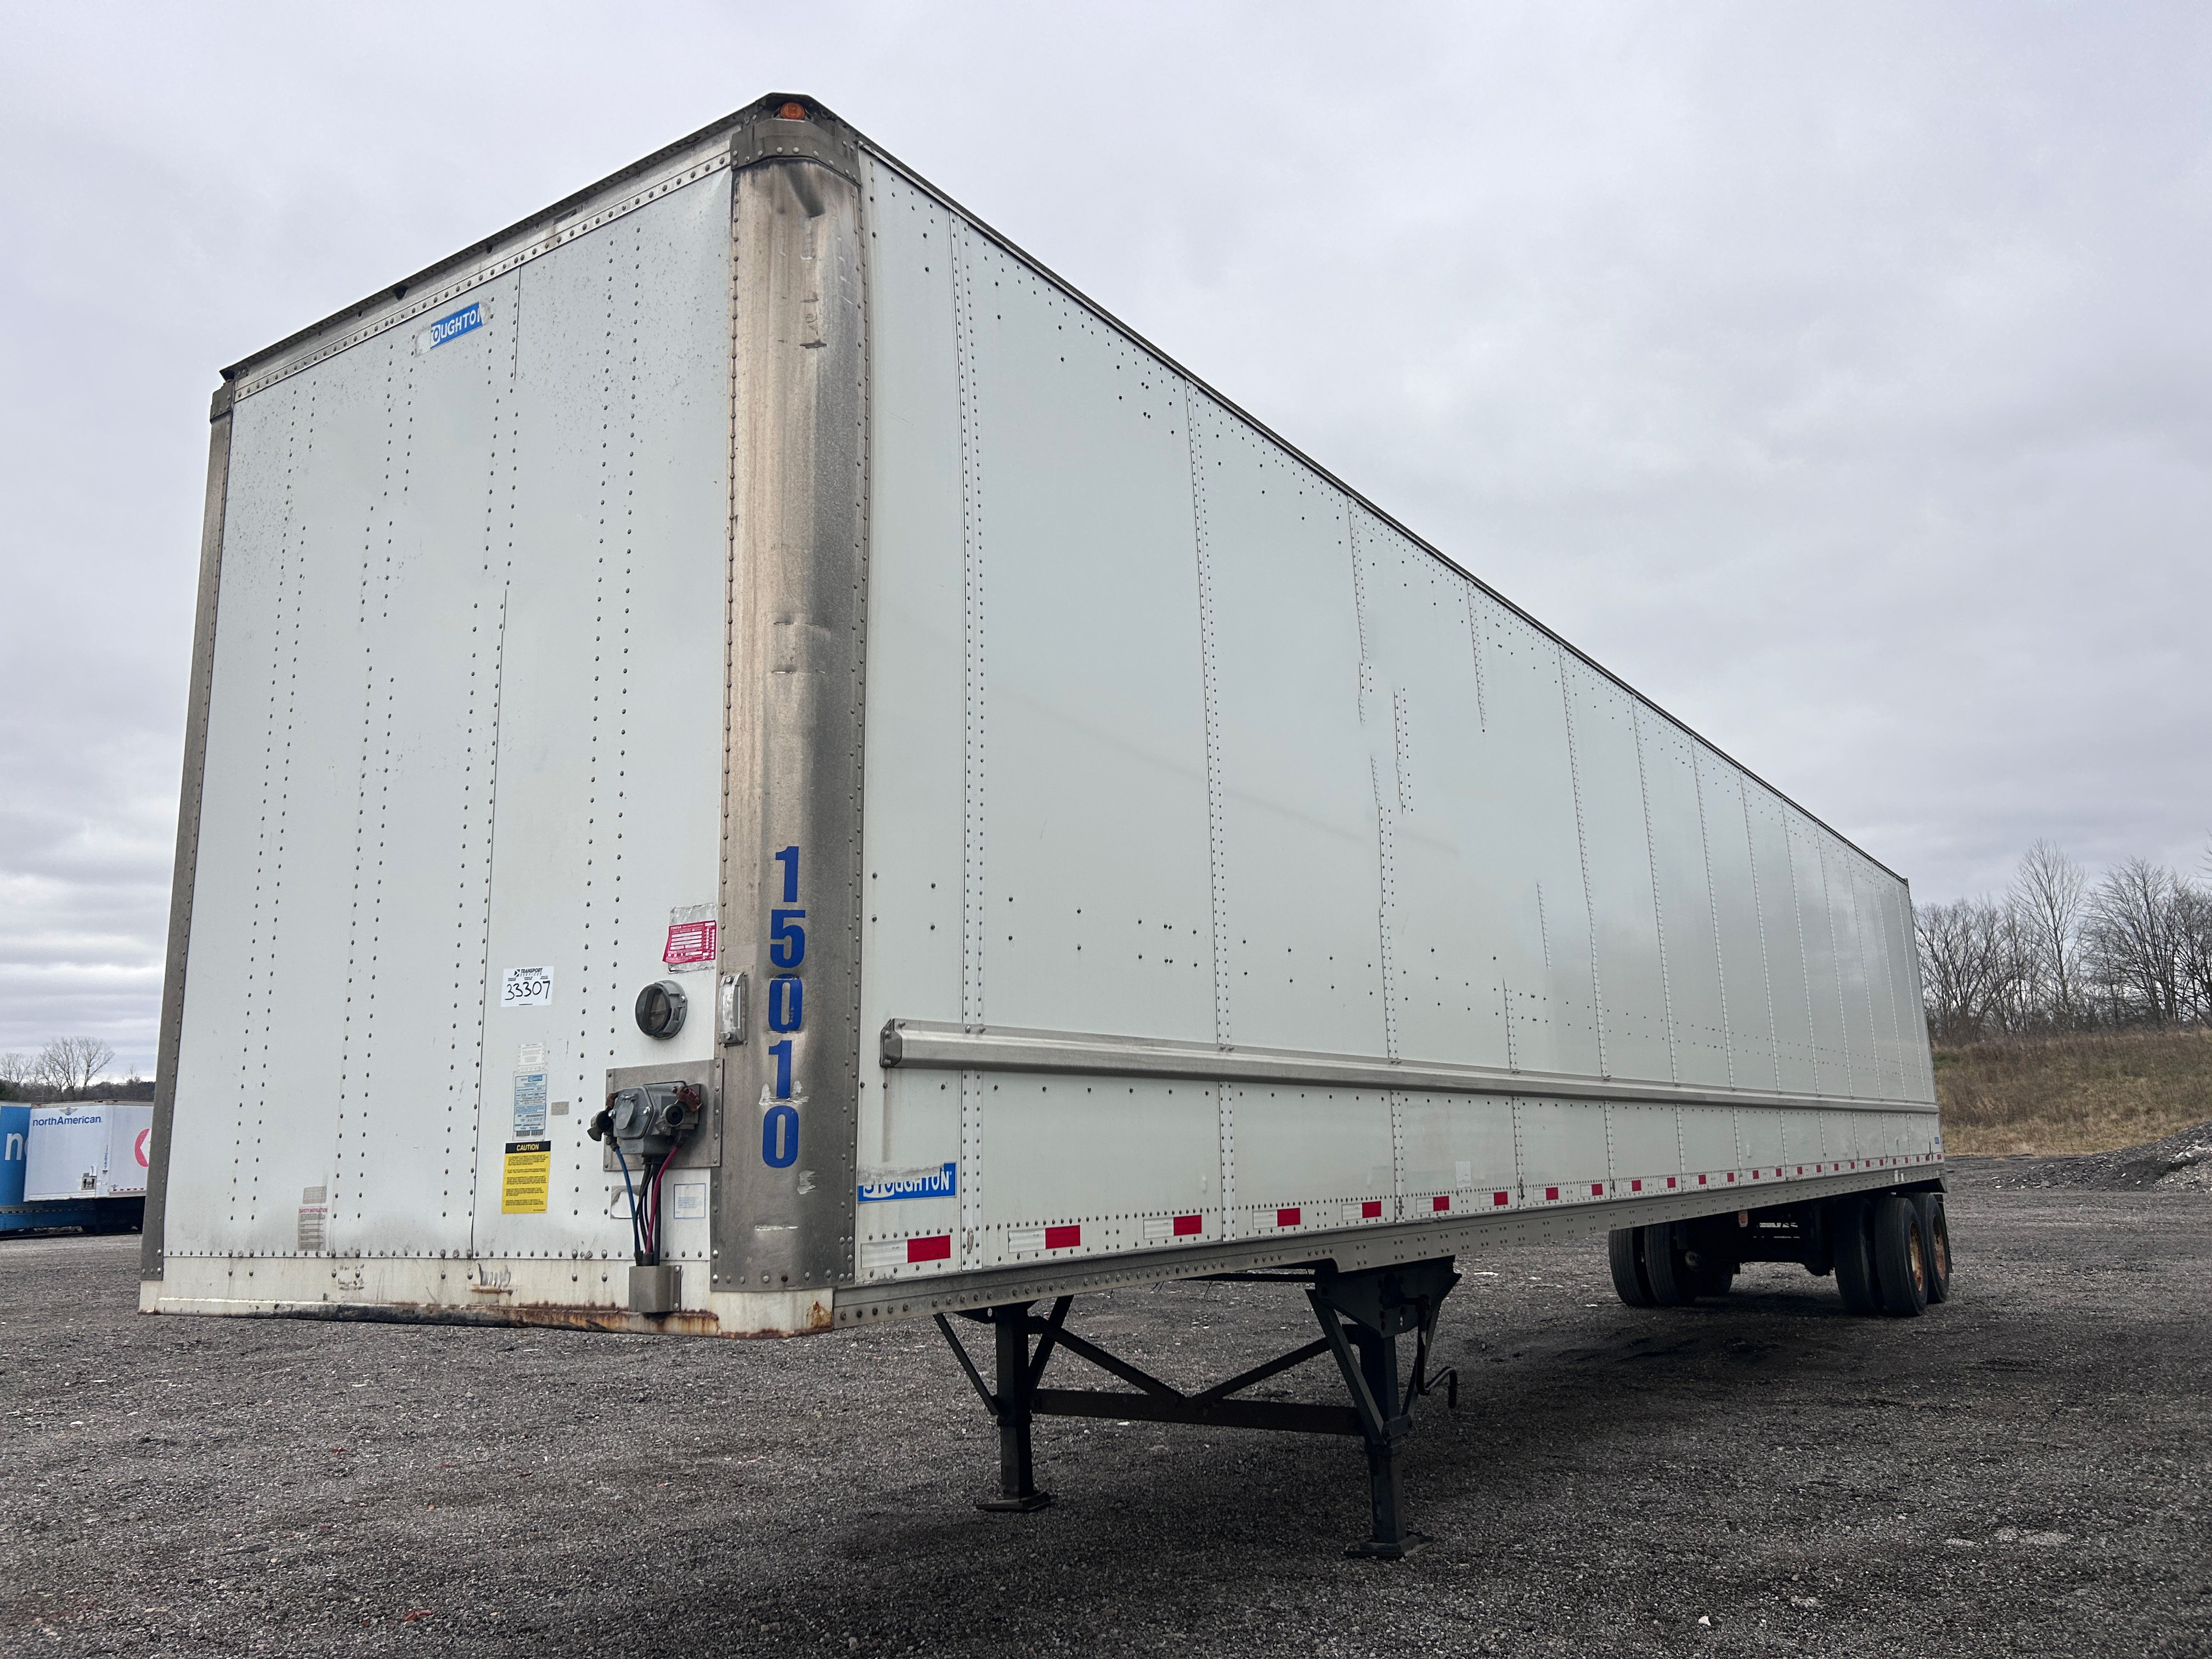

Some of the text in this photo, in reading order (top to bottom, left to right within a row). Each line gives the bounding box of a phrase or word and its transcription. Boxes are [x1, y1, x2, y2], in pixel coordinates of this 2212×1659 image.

[504, 980, 550, 1001] 33307
[762, 845, 806, 1169] 15010
[32, 1115, 101, 1126] northAmerican
[4, 1132, 28, 1161] n
